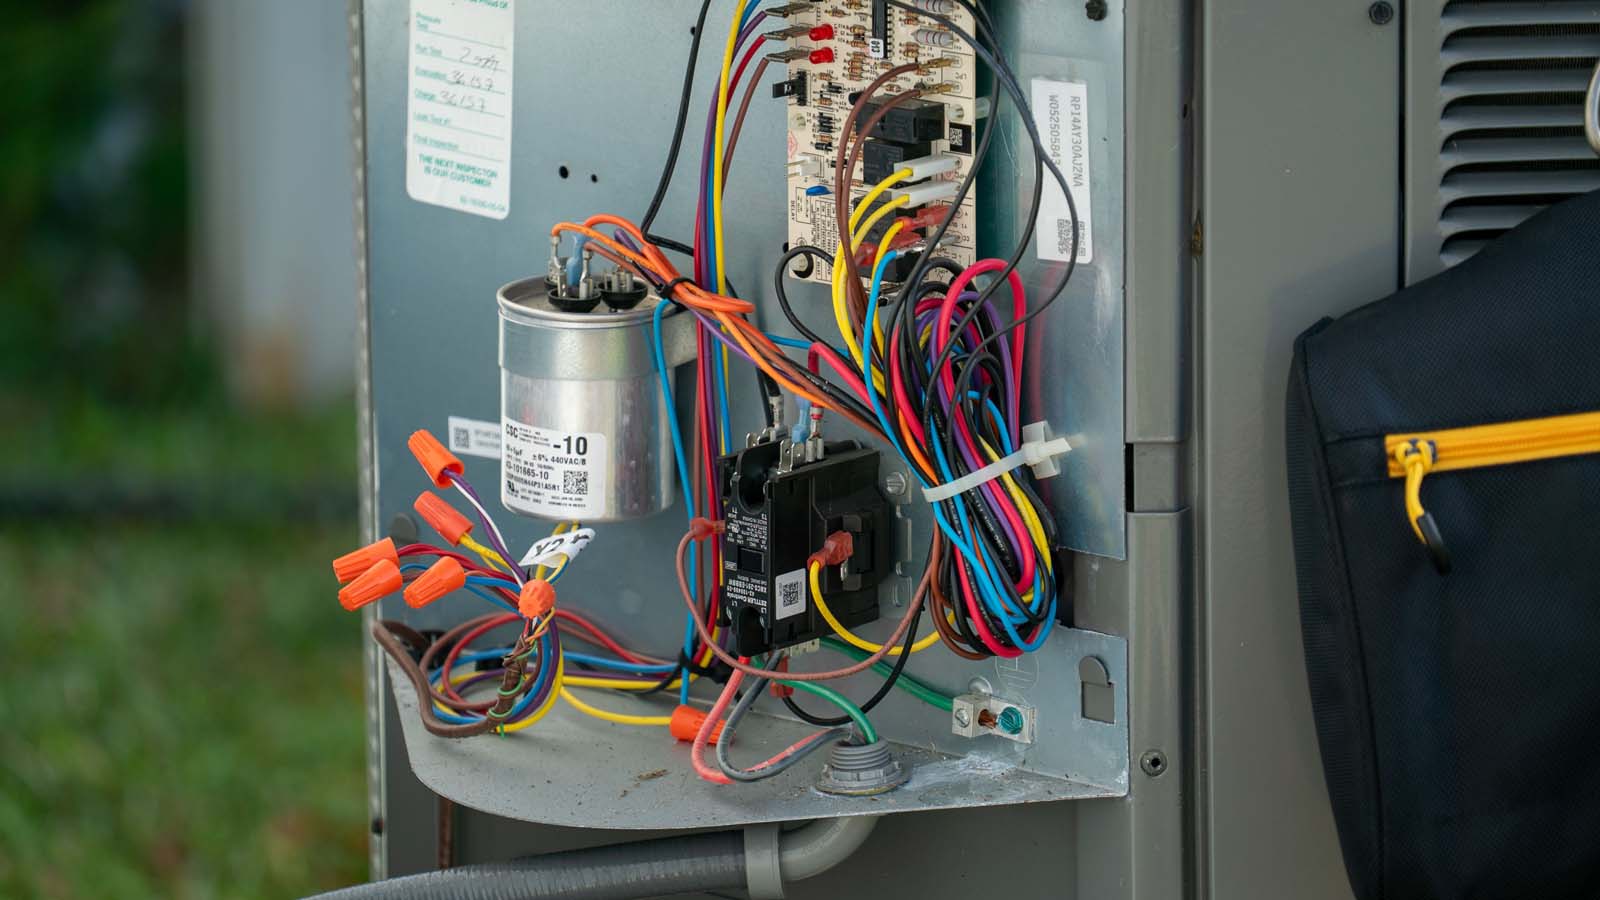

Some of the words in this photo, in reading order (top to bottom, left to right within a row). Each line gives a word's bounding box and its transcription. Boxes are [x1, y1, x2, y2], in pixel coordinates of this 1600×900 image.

[1070, 95, 1084, 188] RP14AY30AJ2NA
[418, 153, 433, 164] THE
[434, 157, 455, 169] NEXT
[456, 162, 498, 178] INSPECTOR
[432, 167, 449, 177] OUR
[450, 170, 492, 187] CUSTOMER
[505, 423, 519, 439] CSC
[553, 435, 588, 455] -10
[727, 592, 747, 602] Controls
[747, 596, 767, 607] ZETTLER
